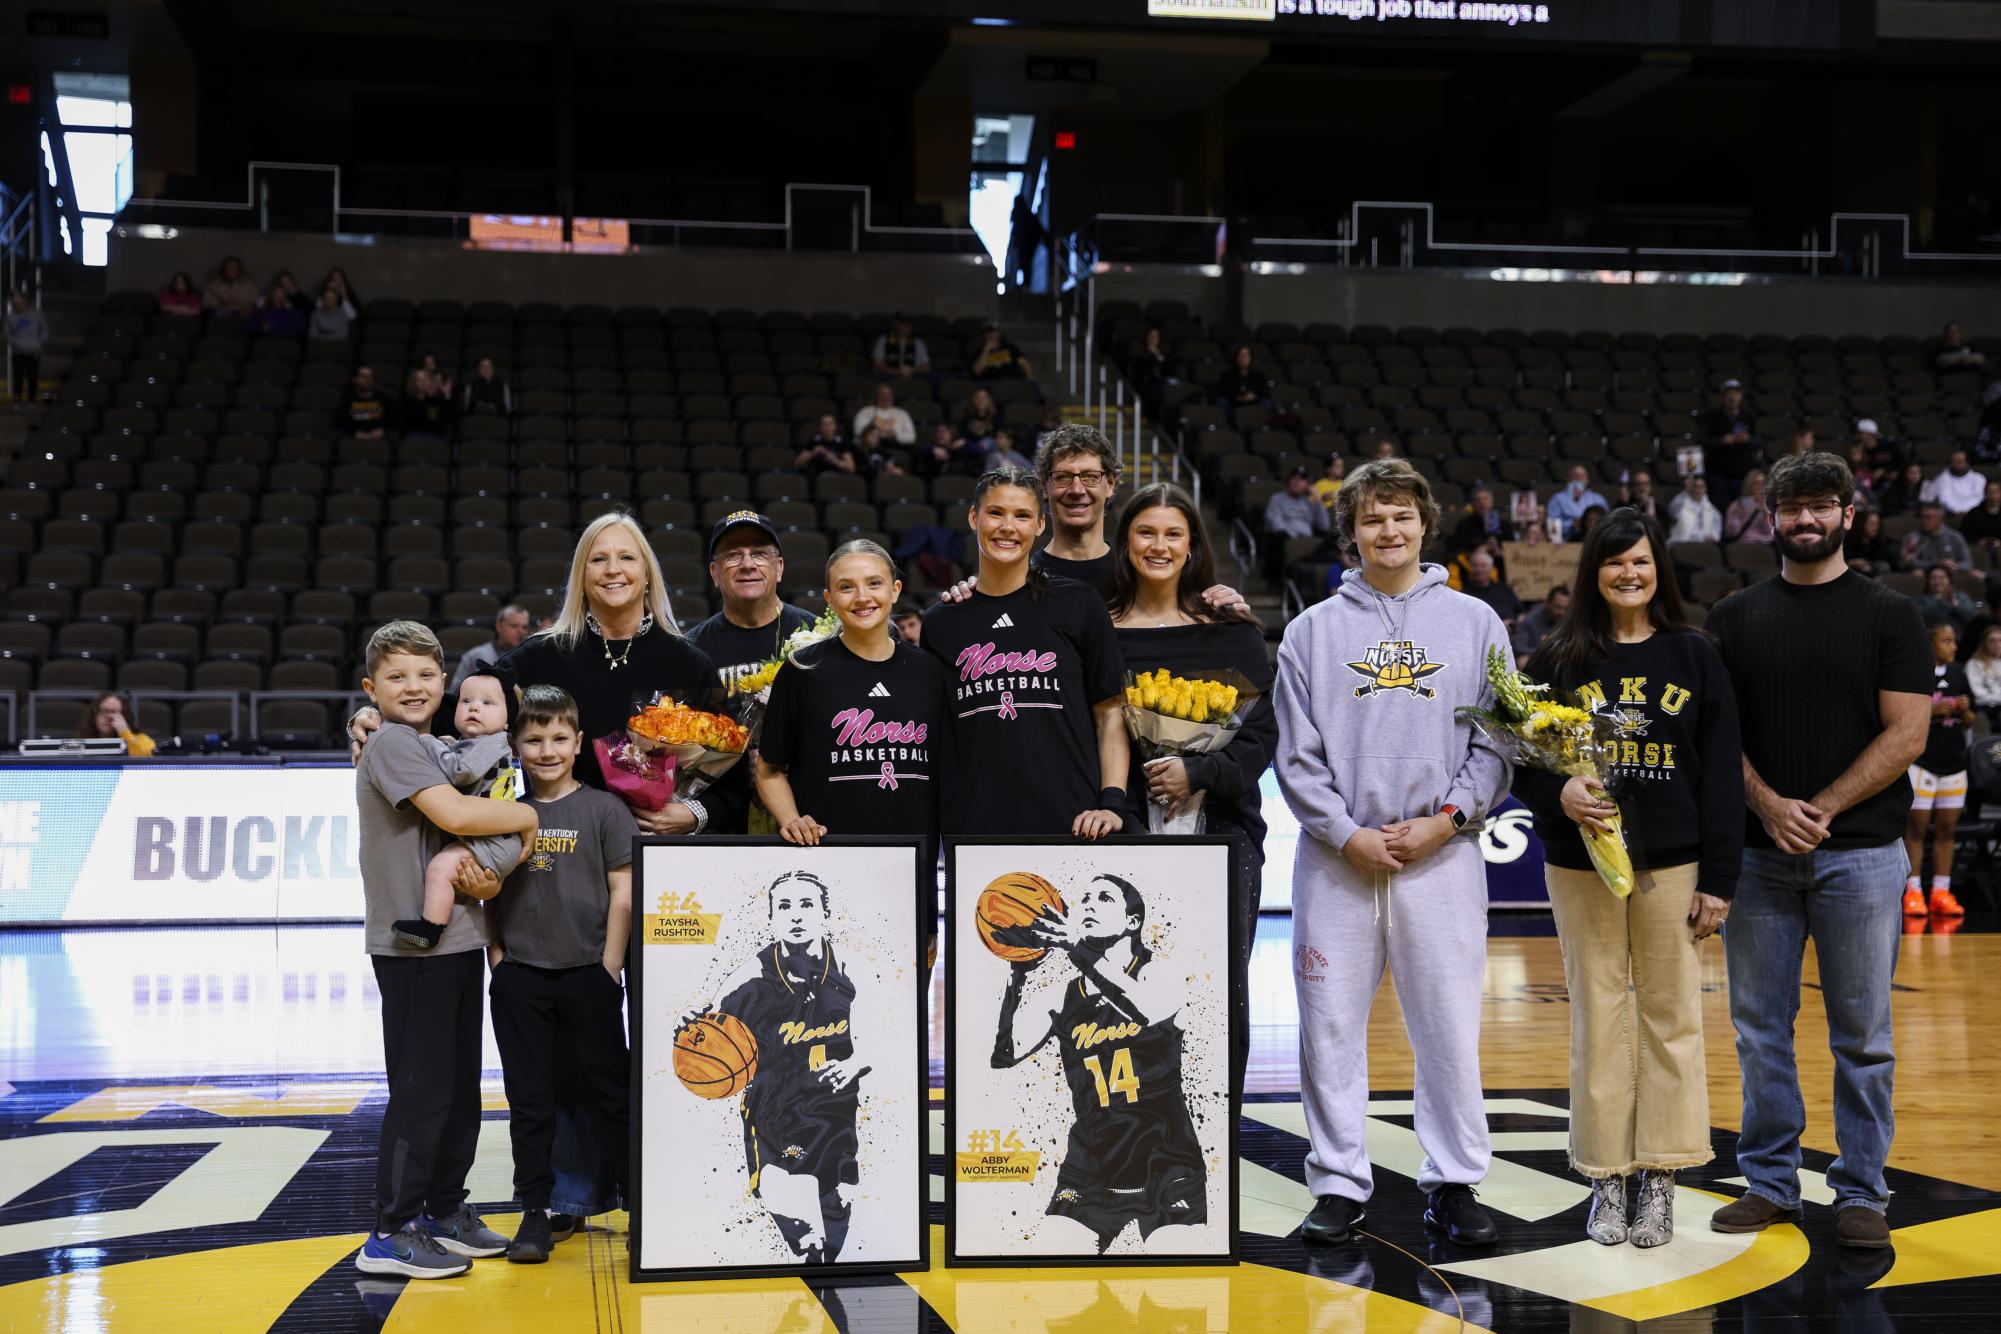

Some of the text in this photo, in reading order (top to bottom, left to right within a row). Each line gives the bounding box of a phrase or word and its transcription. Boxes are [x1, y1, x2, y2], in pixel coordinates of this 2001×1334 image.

[1414, 0, 1456, 19] that
[1459, 2, 1532, 26] annoys
[1535, 4, 1549, 22] a
[956, 642, 1057, 682] Norse
[957, 676, 1061, 700] BASKETBALL
[832, 707, 928, 747] Norse
[831, 747, 929, 764] BASKETBALL
[1602, 740, 1676, 768] ORSE
[1613, 768, 1671, 780] KETBALL
[535, 837, 577, 853] ERSITY
[544, 828, 579, 839] KENTUCKY
[133, 815, 360, 882] BUCKL
[657, 891, 703, 915] #4
[654, 928, 705, 937] RUSHTON
[659, 918, 700, 927] TAYSHA
[1308, 947, 1329, 968] STATE
[779, 1019, 849, 1046] Norse
[1072, 1022, 1141, 1049] Norse
[1083, 1048, 1140, 1107] 14
[967, 1129, 1025, 1153] #14
[962, 1165, 1029, 1175] WOLTERMAN
[981, 1156, 1010, 1165] ABBY
